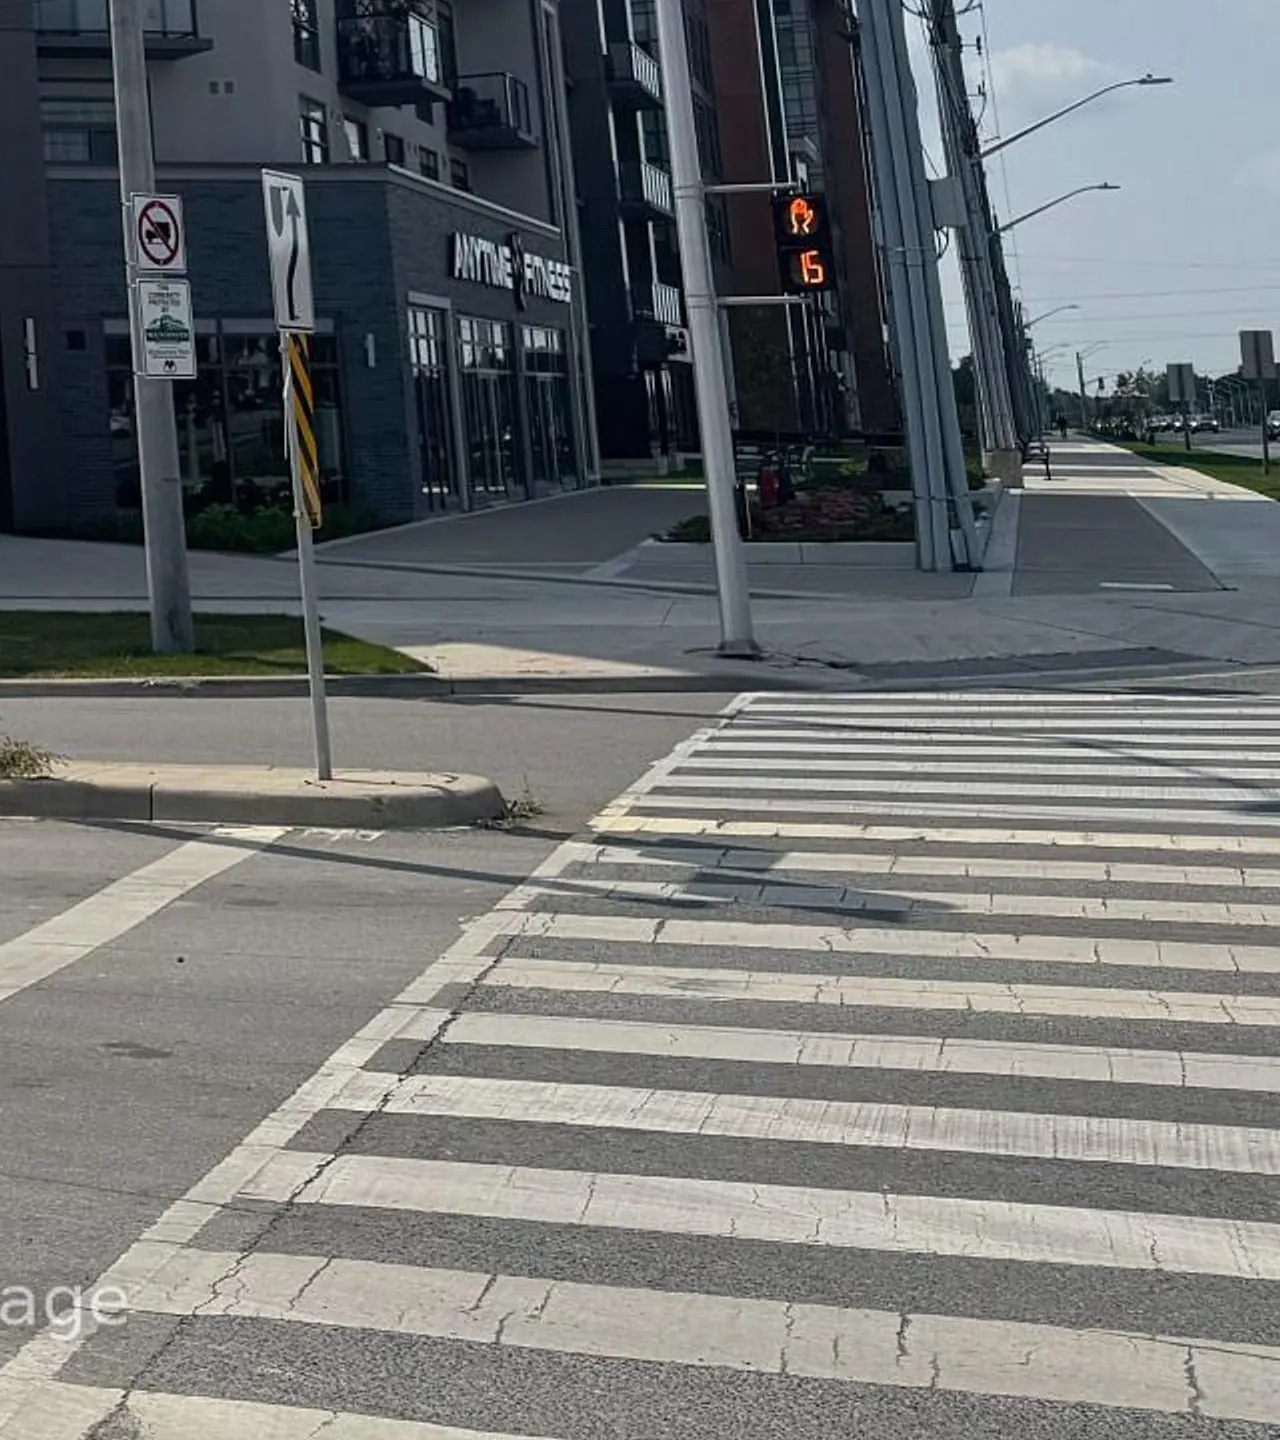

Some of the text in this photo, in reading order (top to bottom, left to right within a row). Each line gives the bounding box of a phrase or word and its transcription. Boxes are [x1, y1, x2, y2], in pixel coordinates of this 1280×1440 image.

[454, 231, 571, 303] ANYTIME FITNESS
[801, 250, 824, 284] 15
